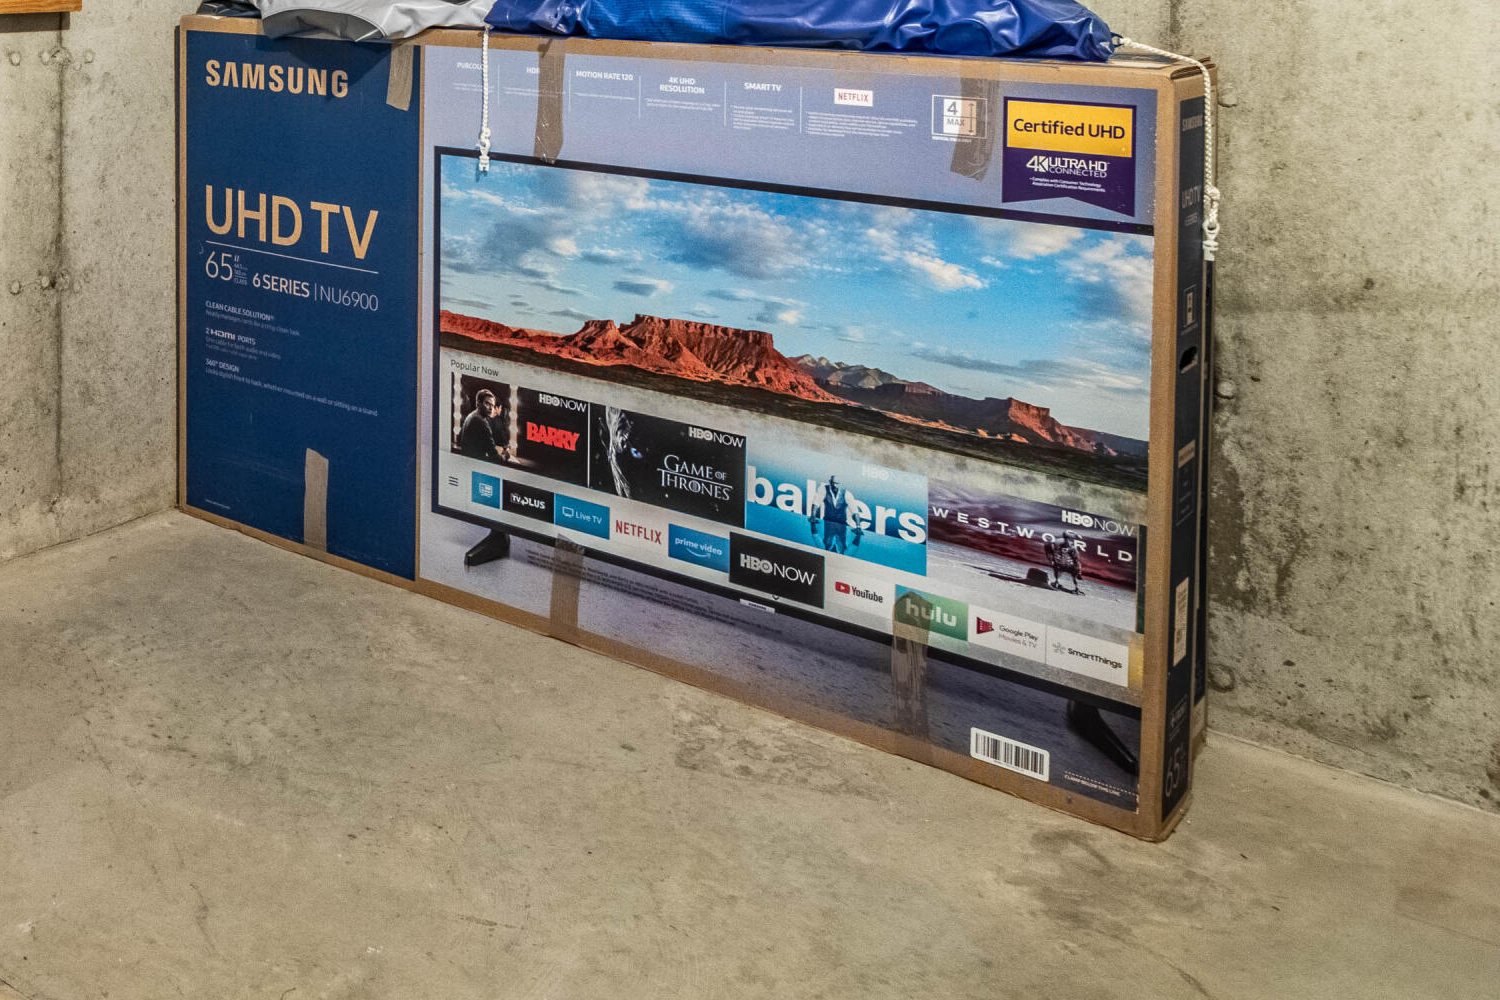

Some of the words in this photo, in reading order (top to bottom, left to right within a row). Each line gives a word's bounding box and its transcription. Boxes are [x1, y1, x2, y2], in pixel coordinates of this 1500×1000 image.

[205, 59, 348, 98] SAMSUNG
[575, 70, 603, 80] MOTION
[603, 72, 621, 81] RATE
[621, 73, 634, 81] 120
[668, 76, 679, 84] 4K
[679, 77, 696, 86] UHD
[659, 84, 705, 95] RESOLUTION
[743, 82, 771, 91] SMART
[771, 84, 782, 92] TV
[837, 92, 869, 103] NETFLIX
[947, 101, 958, 116] 4
[947, 118, 965, 127] MAX
[1013, 118, 1085, 137] Certified
[1088, 123, 1125, 139] UHD
[1026, 155, 1049, 172] 4K
[1048, 156, 1087, 170] ULTRA
[1088, 160, 1108, 172] HD
[1048, 167, 1108, 178] CONNECTED
[205, 184, 303, 246] UHD
[310, 201, 379, 260] TV
[252, 272, 261, 288] 6
[262, 274, 310, 298] SERIES
[320, 285, 379, 312] NU6900
[205, 300, 223, 311] CLEAN
[224, 304, 241, 315] CABLE
[205, 327, 210, 335] 2
[237, 334, 256, 345] PORTS
[218, 361, 240, 373] DESIGN
[450, 359, 480, 373] Popular
[482, 366, 499, 377] Now
[526, 421, 580, 451] BARRY
[663, 454, 714, 480] GAME
[714, 471, 727, 481] OF
[660, 469, 730, 501] THRONES
[575, 511, 591, 522] Live
[592, 515, 602, 525] TV
[615, 519, 662, 545] NETFLIX
[675, 536, 699, 550] prime
[700, 542, 723, 556] video
[851, 586, 883, 604] YouTube
[906, 598, 957, 627] hulu
[998, 633, 1020, 645] Movies
[999, 625, 1023, 637] Google
[1024, 632, 1038, 641] Play
[1067, 647, 1122, 669] SmartThings
